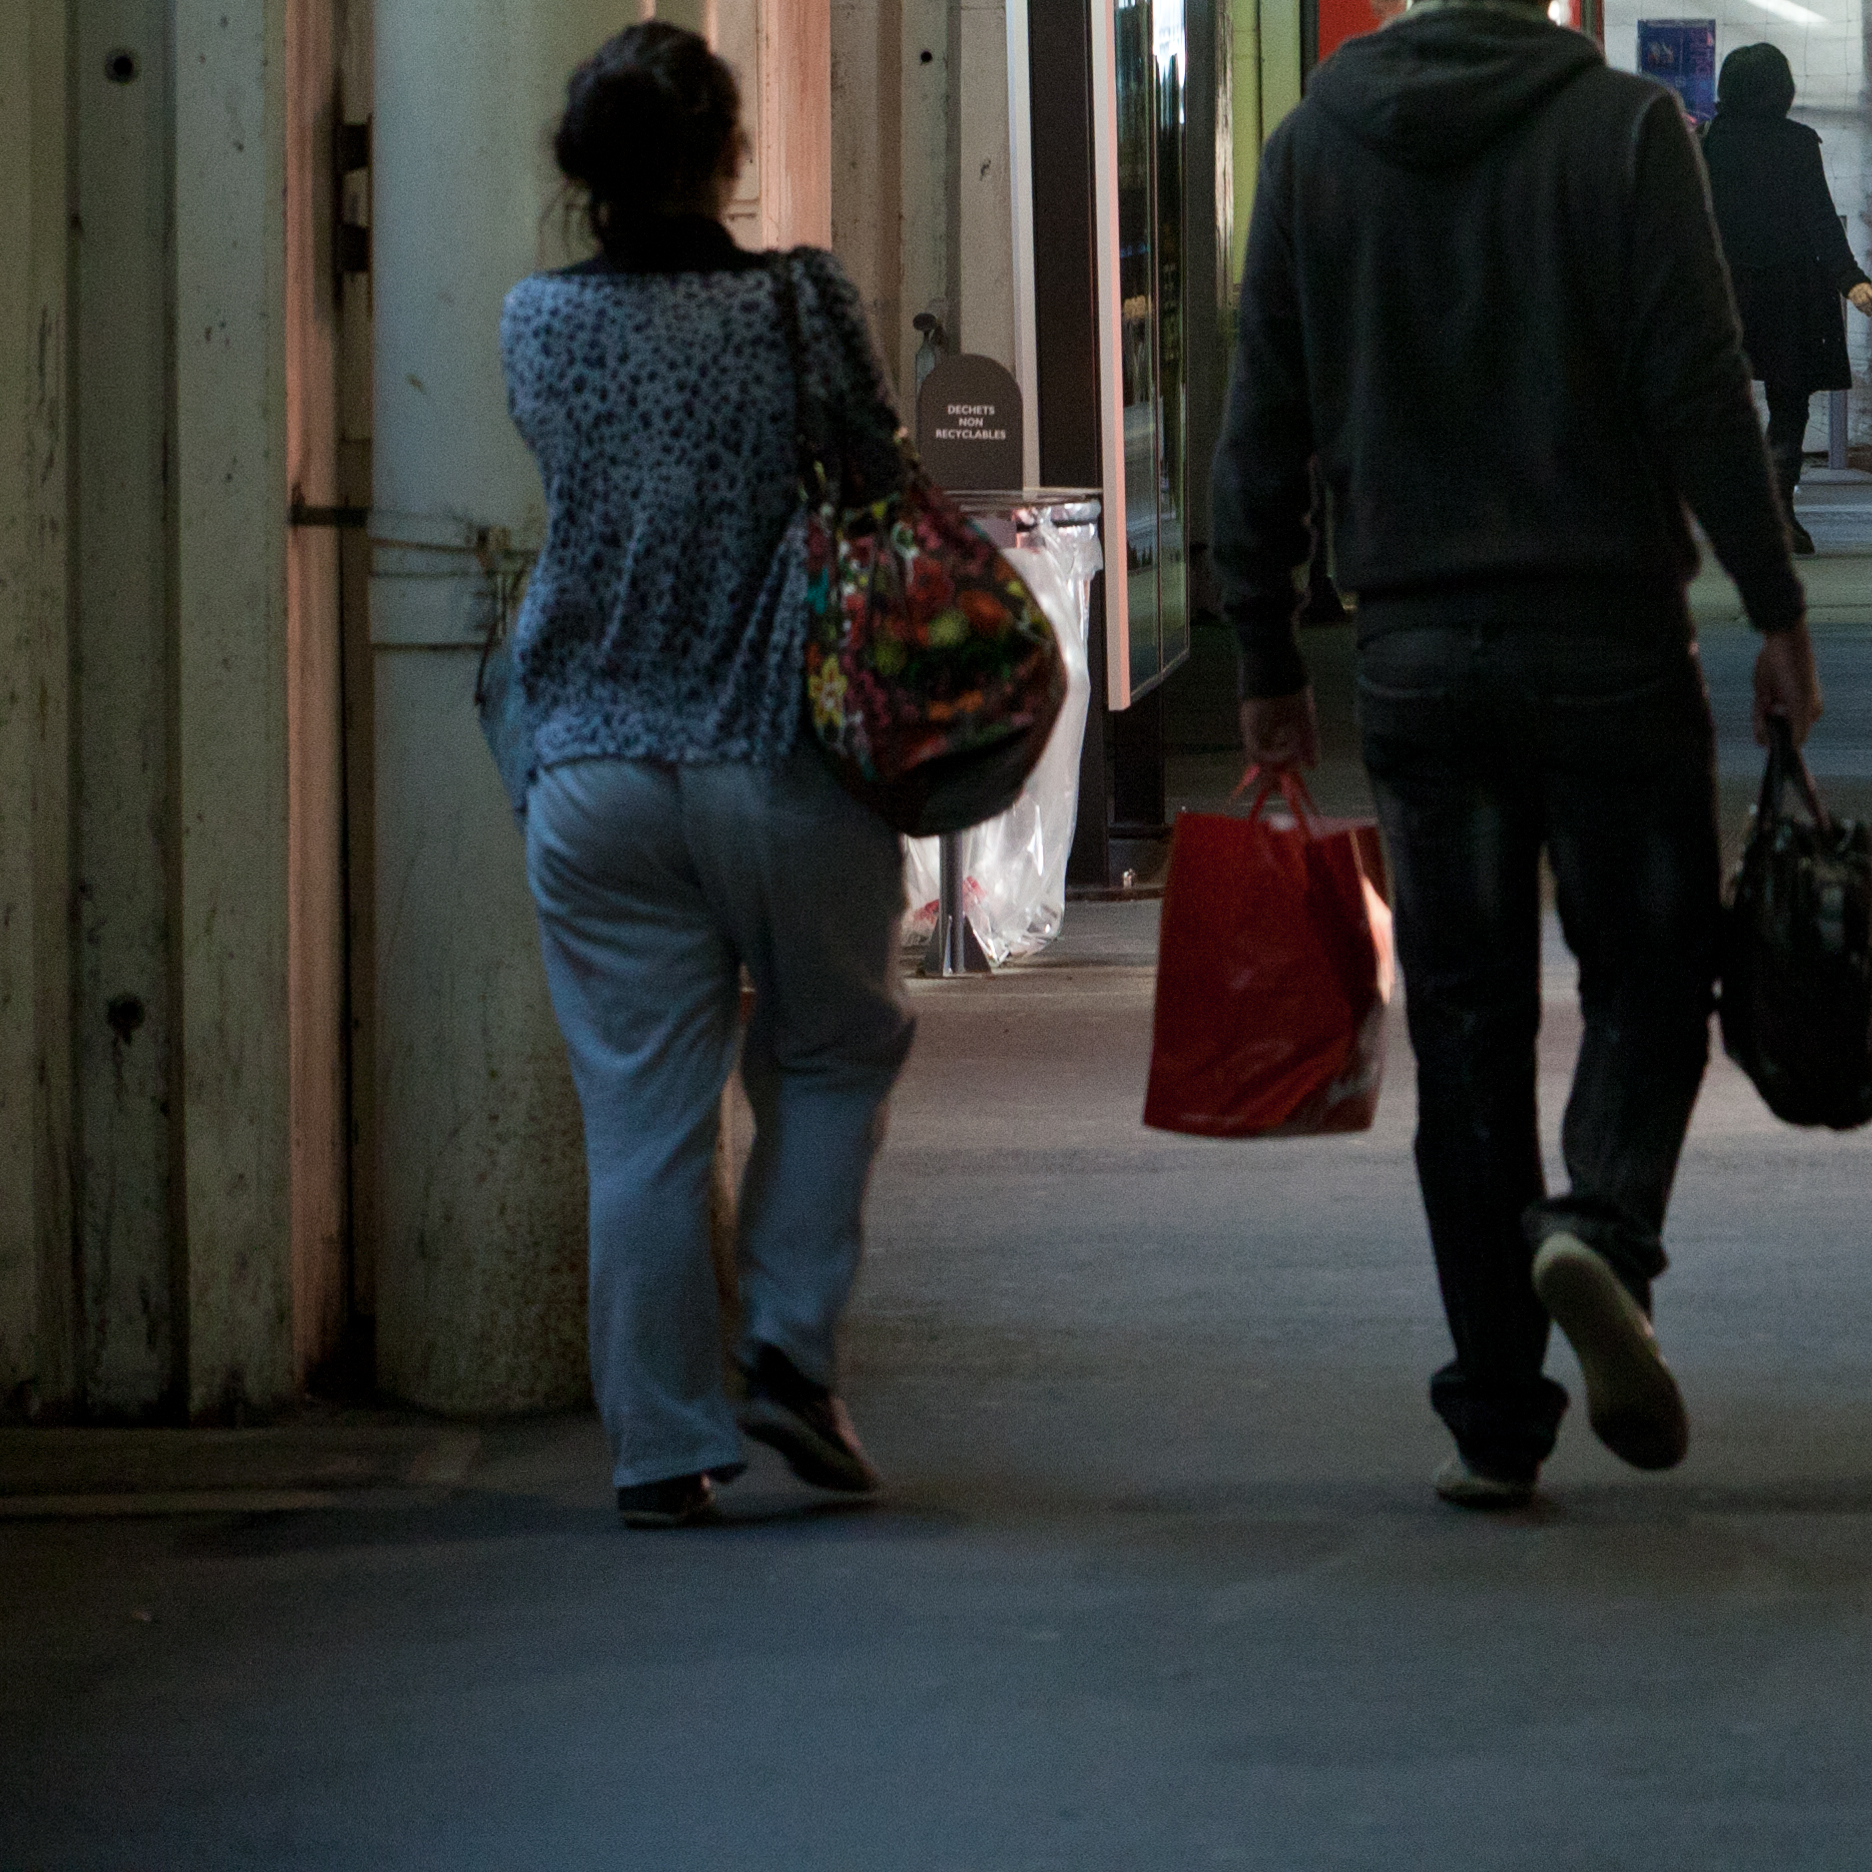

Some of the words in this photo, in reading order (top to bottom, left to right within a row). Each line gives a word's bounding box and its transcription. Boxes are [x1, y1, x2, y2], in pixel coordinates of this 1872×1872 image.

[947, 404, 995, 415] DECHETS
[958, 417, 984, 427] NON
[936, 429, 1006, 440] RECYCLABLES
